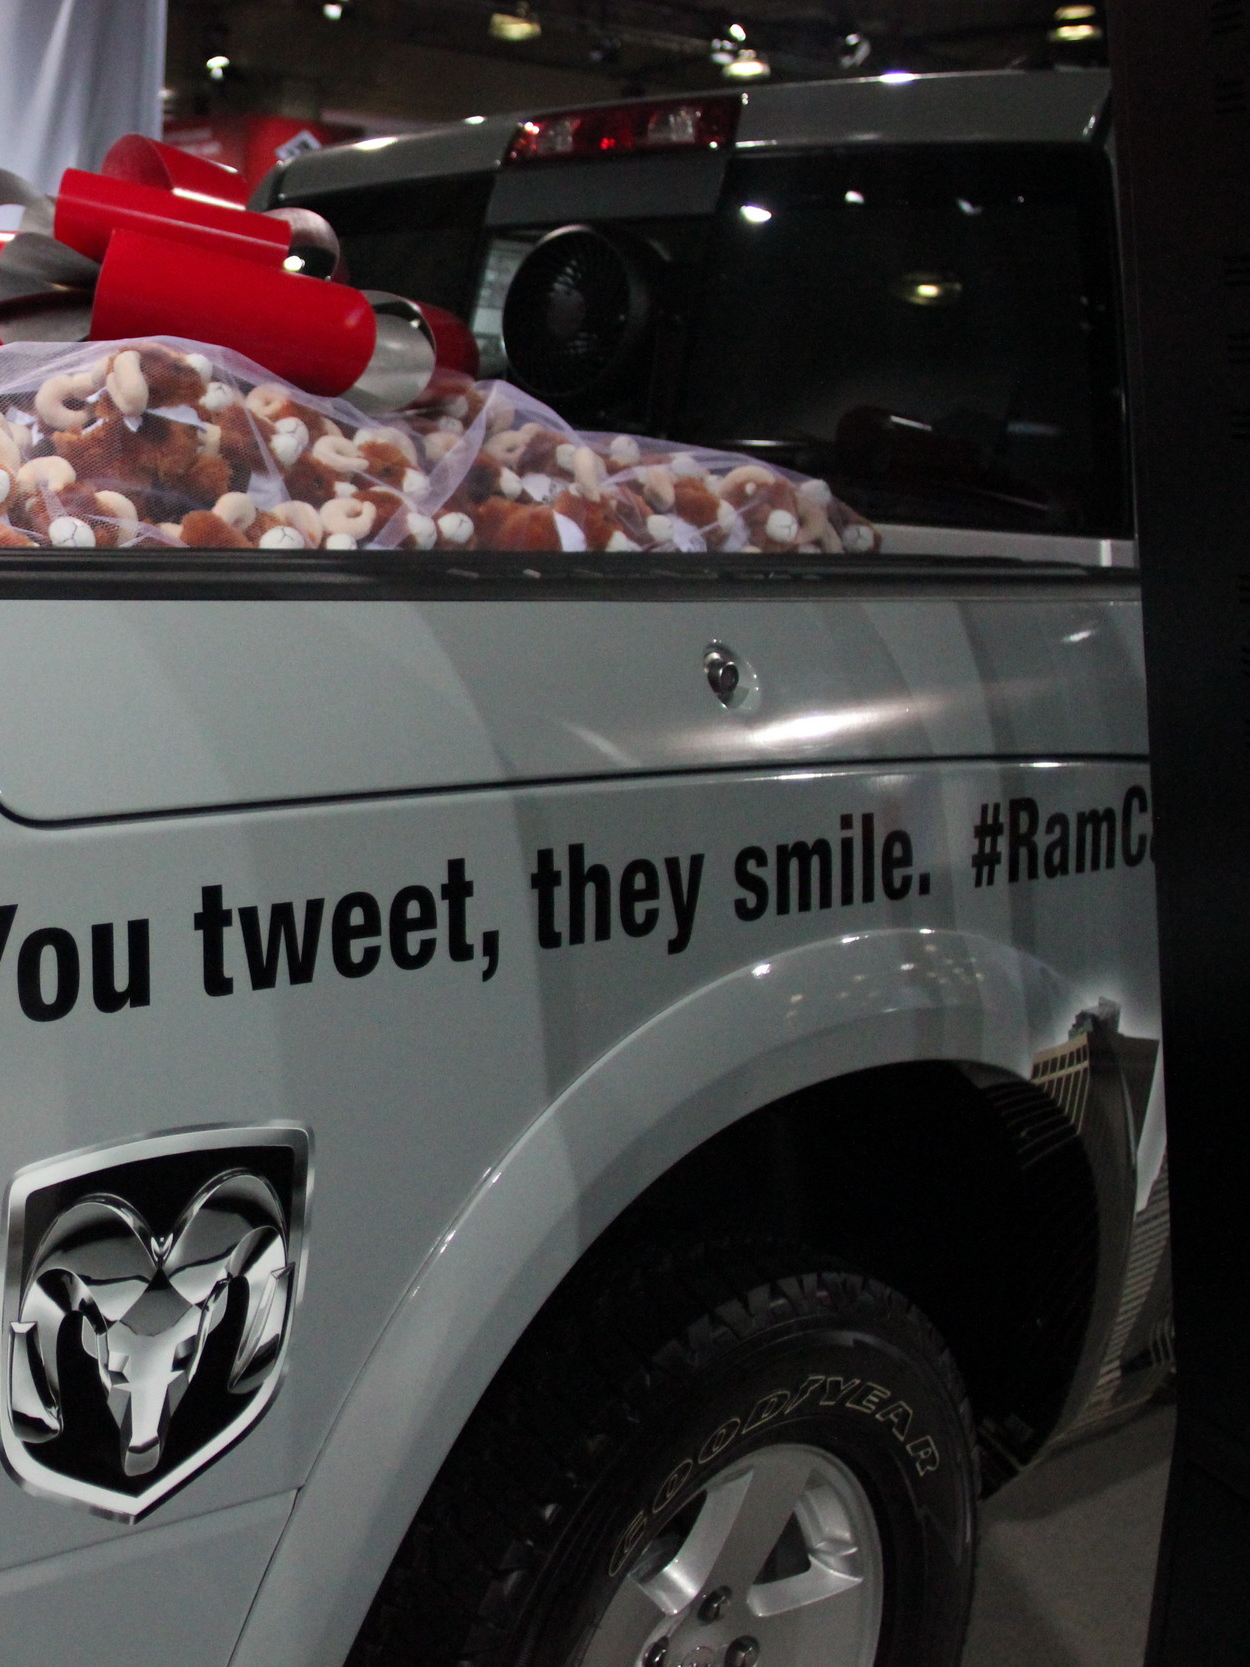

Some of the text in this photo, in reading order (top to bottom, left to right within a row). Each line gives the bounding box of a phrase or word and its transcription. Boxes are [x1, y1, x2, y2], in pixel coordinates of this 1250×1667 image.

[194, 857, 501, 996] tweet,
[530, 842, 706, 955] they
[733, 813, 931, 922] smile.
[608, 1375, 940, 1578] GOODYEAR
